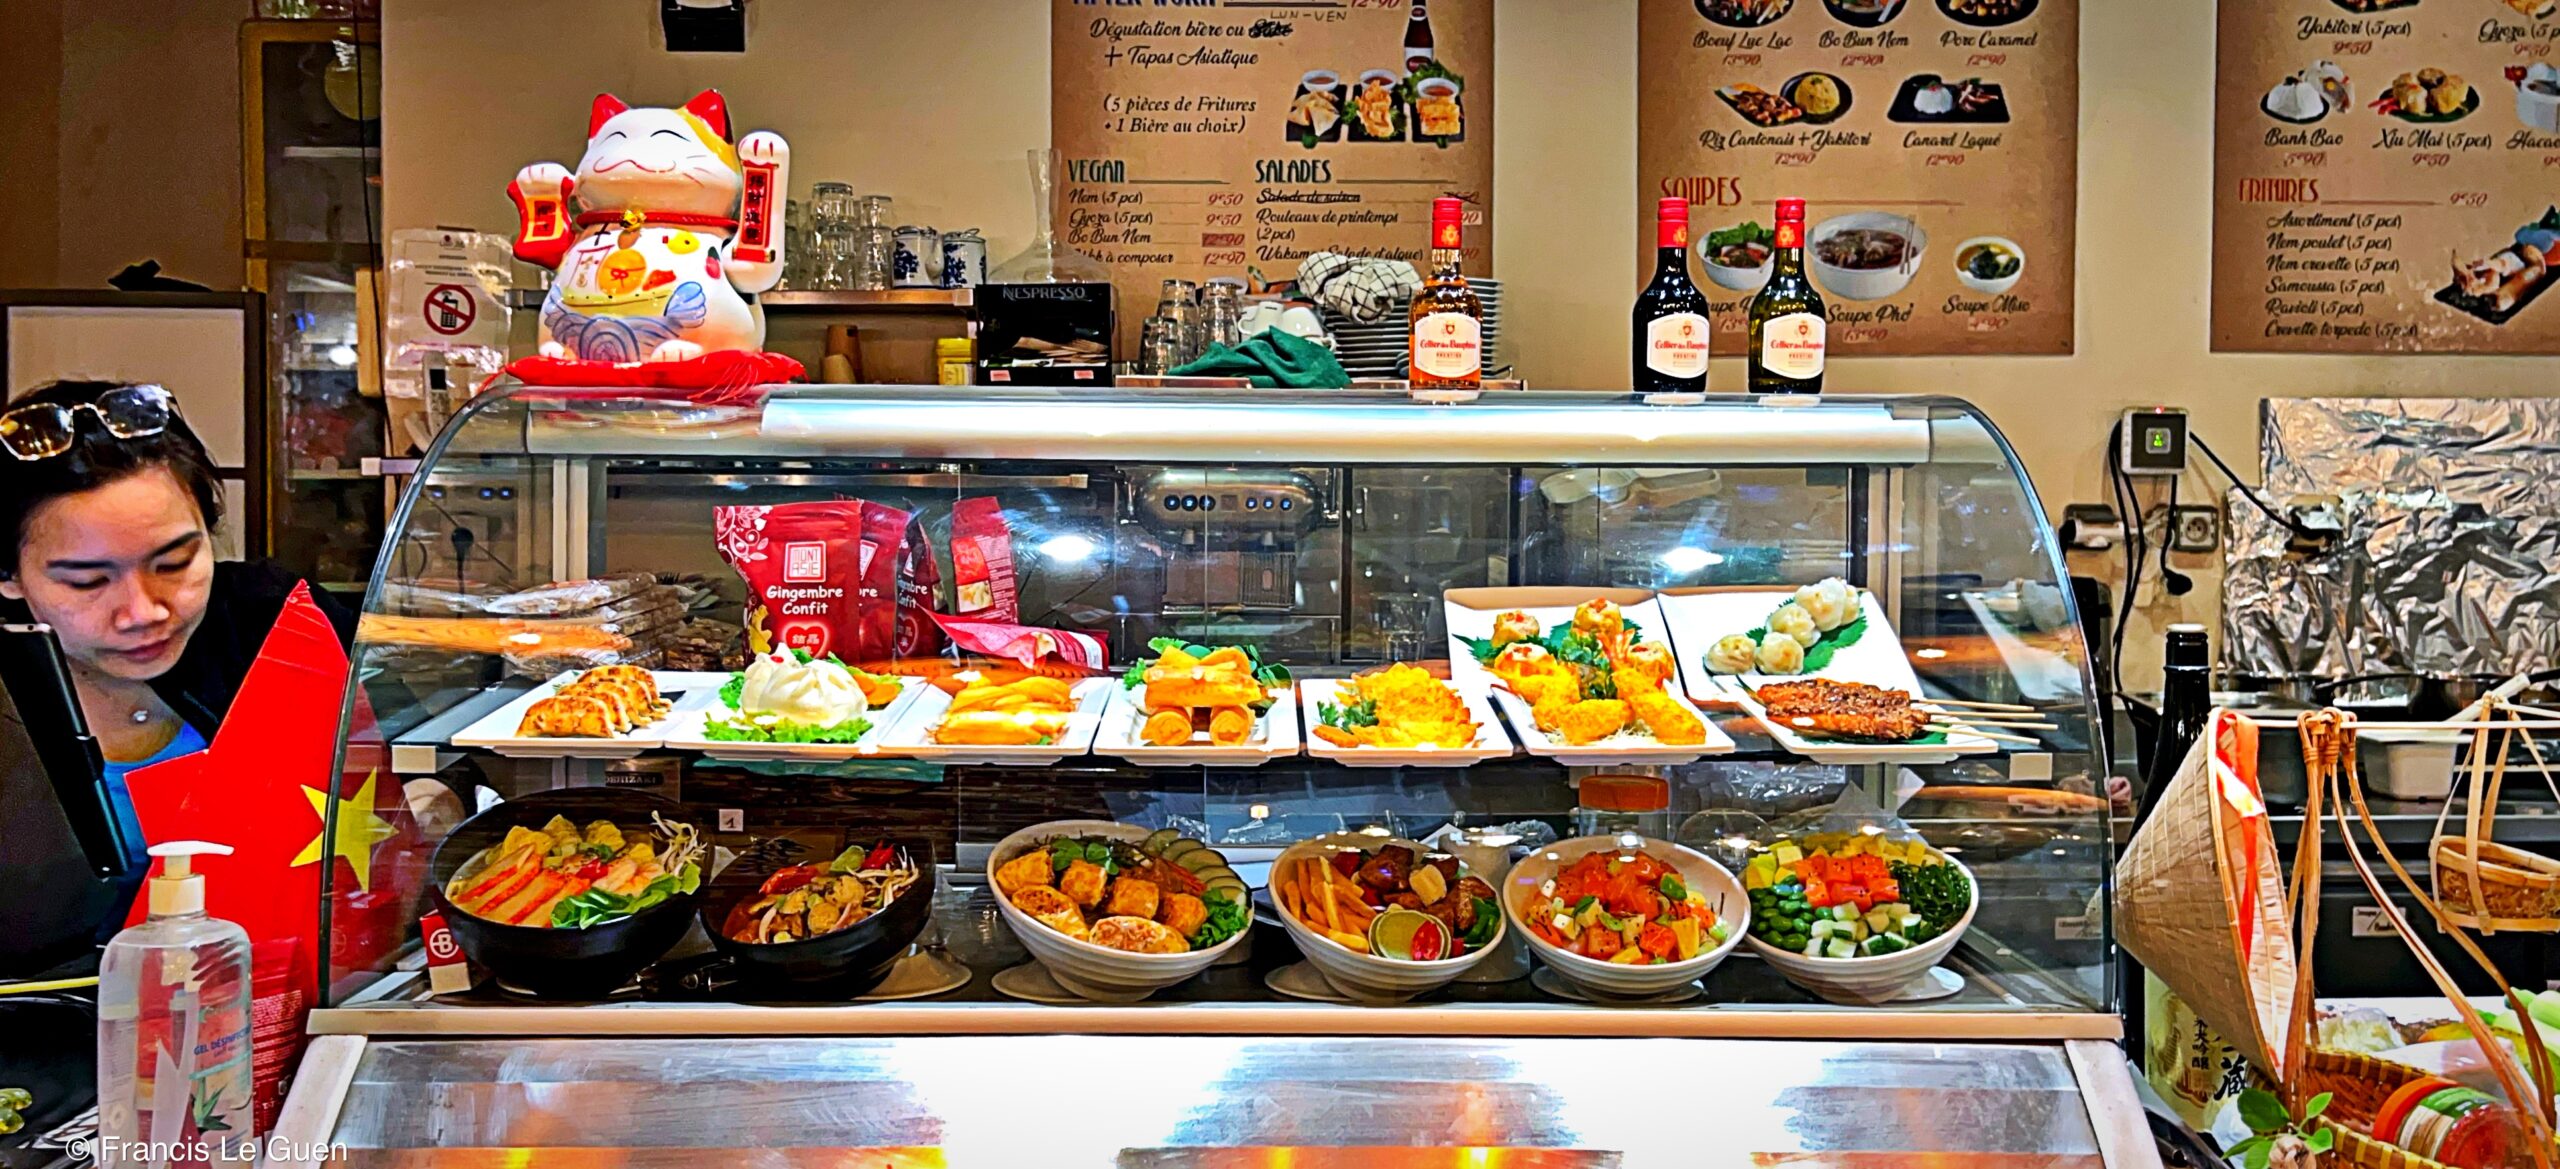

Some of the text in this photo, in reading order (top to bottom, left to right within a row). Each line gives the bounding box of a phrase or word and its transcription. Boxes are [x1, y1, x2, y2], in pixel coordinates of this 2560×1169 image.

[1315, 11, 1347, 22] VEN
[1090, 17, 1181, 41] Dégustation
[1185, 20, 1223, 37] bière
[1226, 25, 1244, 37] ou
[2298, 16, 2363, 40] Yakitori
[1692, 30, 1793, 51] Boeuf Luc Lac
[1818, 30, 1909, 48] Bo Bun Nem
[1939, 30, 2039, 48] Porc Caramel
[1127, 45, 1173, 68] Tapas
[1177, 46, 1259, 68] Asiatique
[1125, 95, 1170, 114] pièces
[1174, 95, 1192, 112] de
[1197, 96, 1257, 112] Fritures
[1130, 117, 1168, 133] Bière
[1173, 122, 1192, 133] au
[1197, 115, 1246, 134] choix)
[1699, 130, 1726, 150] Riz
[1728, 130, 1794, 148] Cantonais
[1810, 130, 1872, 150] Yakitori
[1903, 130, 2002, 151] Canard Laqué
[2264, 128, 2344, 147] Banh Bao
[2372, 128, 2404, 149] Xiu
[2407, 129, 2443, 149] Mai
[1068, 159, 1124, 184] VEGAN
[1255, 159, 1332, 183] SALADES
[1069, 188, 1098, 205] Nem
[1660, 176, 1742, 206] SOUPES
[2239, 178, 2319, 203] FRITURES
[1069, 208, 1111, 229] Gyoza
[1256, 208, 1398, 226] Rouleaux de printemps
[2266, 210, 2356, 228] Assortiment
[1068, 228, 1151, 245] Bo Bun Nem
[2266, 232, 2299, 249] Nem
[2300, 234, 2346, 252] poulet
[1117, 253, 1174, 267] composer
[2266, 254, 2299, 271] Nem
[2302, 257, 2351, 271] crevette
[1003, 286, 1086, 300] NESPRESSO
[2265, 275, 2336, 294] Samoussa
[1943, 294, 1989, 315] Soupe
[2265, 298, 2318, 318] Ravioli
[1826, 304, 1872, 326] Soupe
[2265, 319, 2318, 338] Crevette
[2320, 322, 2371, 339] torpedo
[766, 585, 844, 602] Gingembre
[782, 602, 829, 615] Confit
[194, 1044, 209, 1056] GEL
